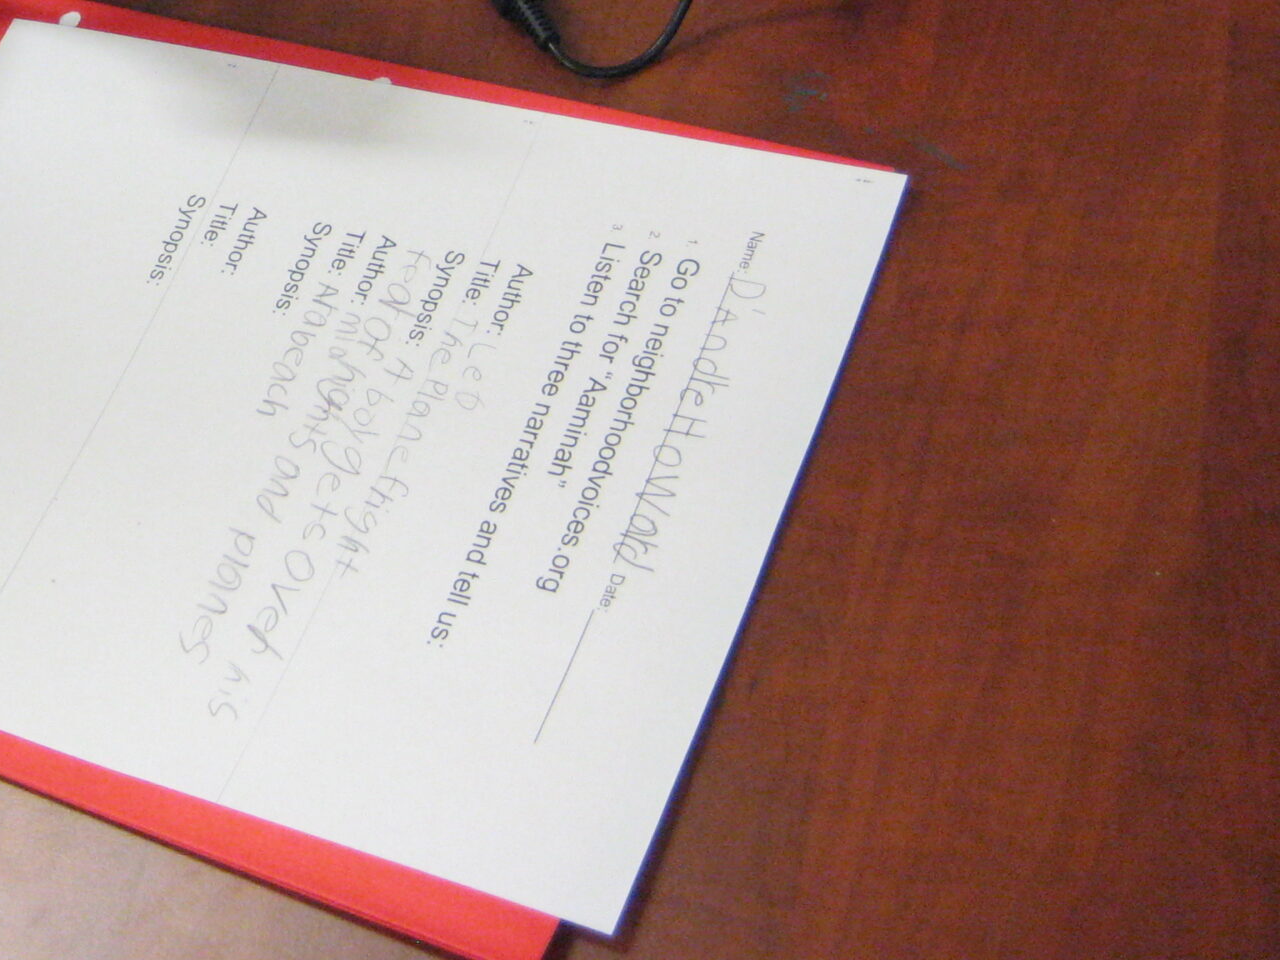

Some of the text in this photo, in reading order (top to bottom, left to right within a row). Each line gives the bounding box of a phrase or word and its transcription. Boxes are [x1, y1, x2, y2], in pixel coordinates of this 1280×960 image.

[146, 193, 206, 286] Synopsis:
[200, 202, 239, 247] Title:
[220, 206, 268, 275] Author:
[272, 221, 332, 316] Synopsis:
[327, 230, 366, 276] Title:
[350, 234, 397, 305] Author:
[579, 241, 626, 306] Listen
[669, 257, 700, 290] Go
[738, 230, 766, 274] Name:
[404, 249, 465, 347] Synopsis:
[461, 259, 501, 305] Title:
[486, 262, 534, 336] Author:
[612, 249, 662, 326] Search
[568, 313, 594, 334] to
[658, 296, 685, 317] to
[540, 340, 583, 396] three
[598, 333, 628, 364] for
[488, 402, 551, 513] narratives
[534, 322, 669, 593] neighborhoodvoices.org
[464, 519, 497, 566] and
[446, 570, 479, 606] tell
[598, 572, 626, 613] Date:
[426, 611, 457, 648] us:
